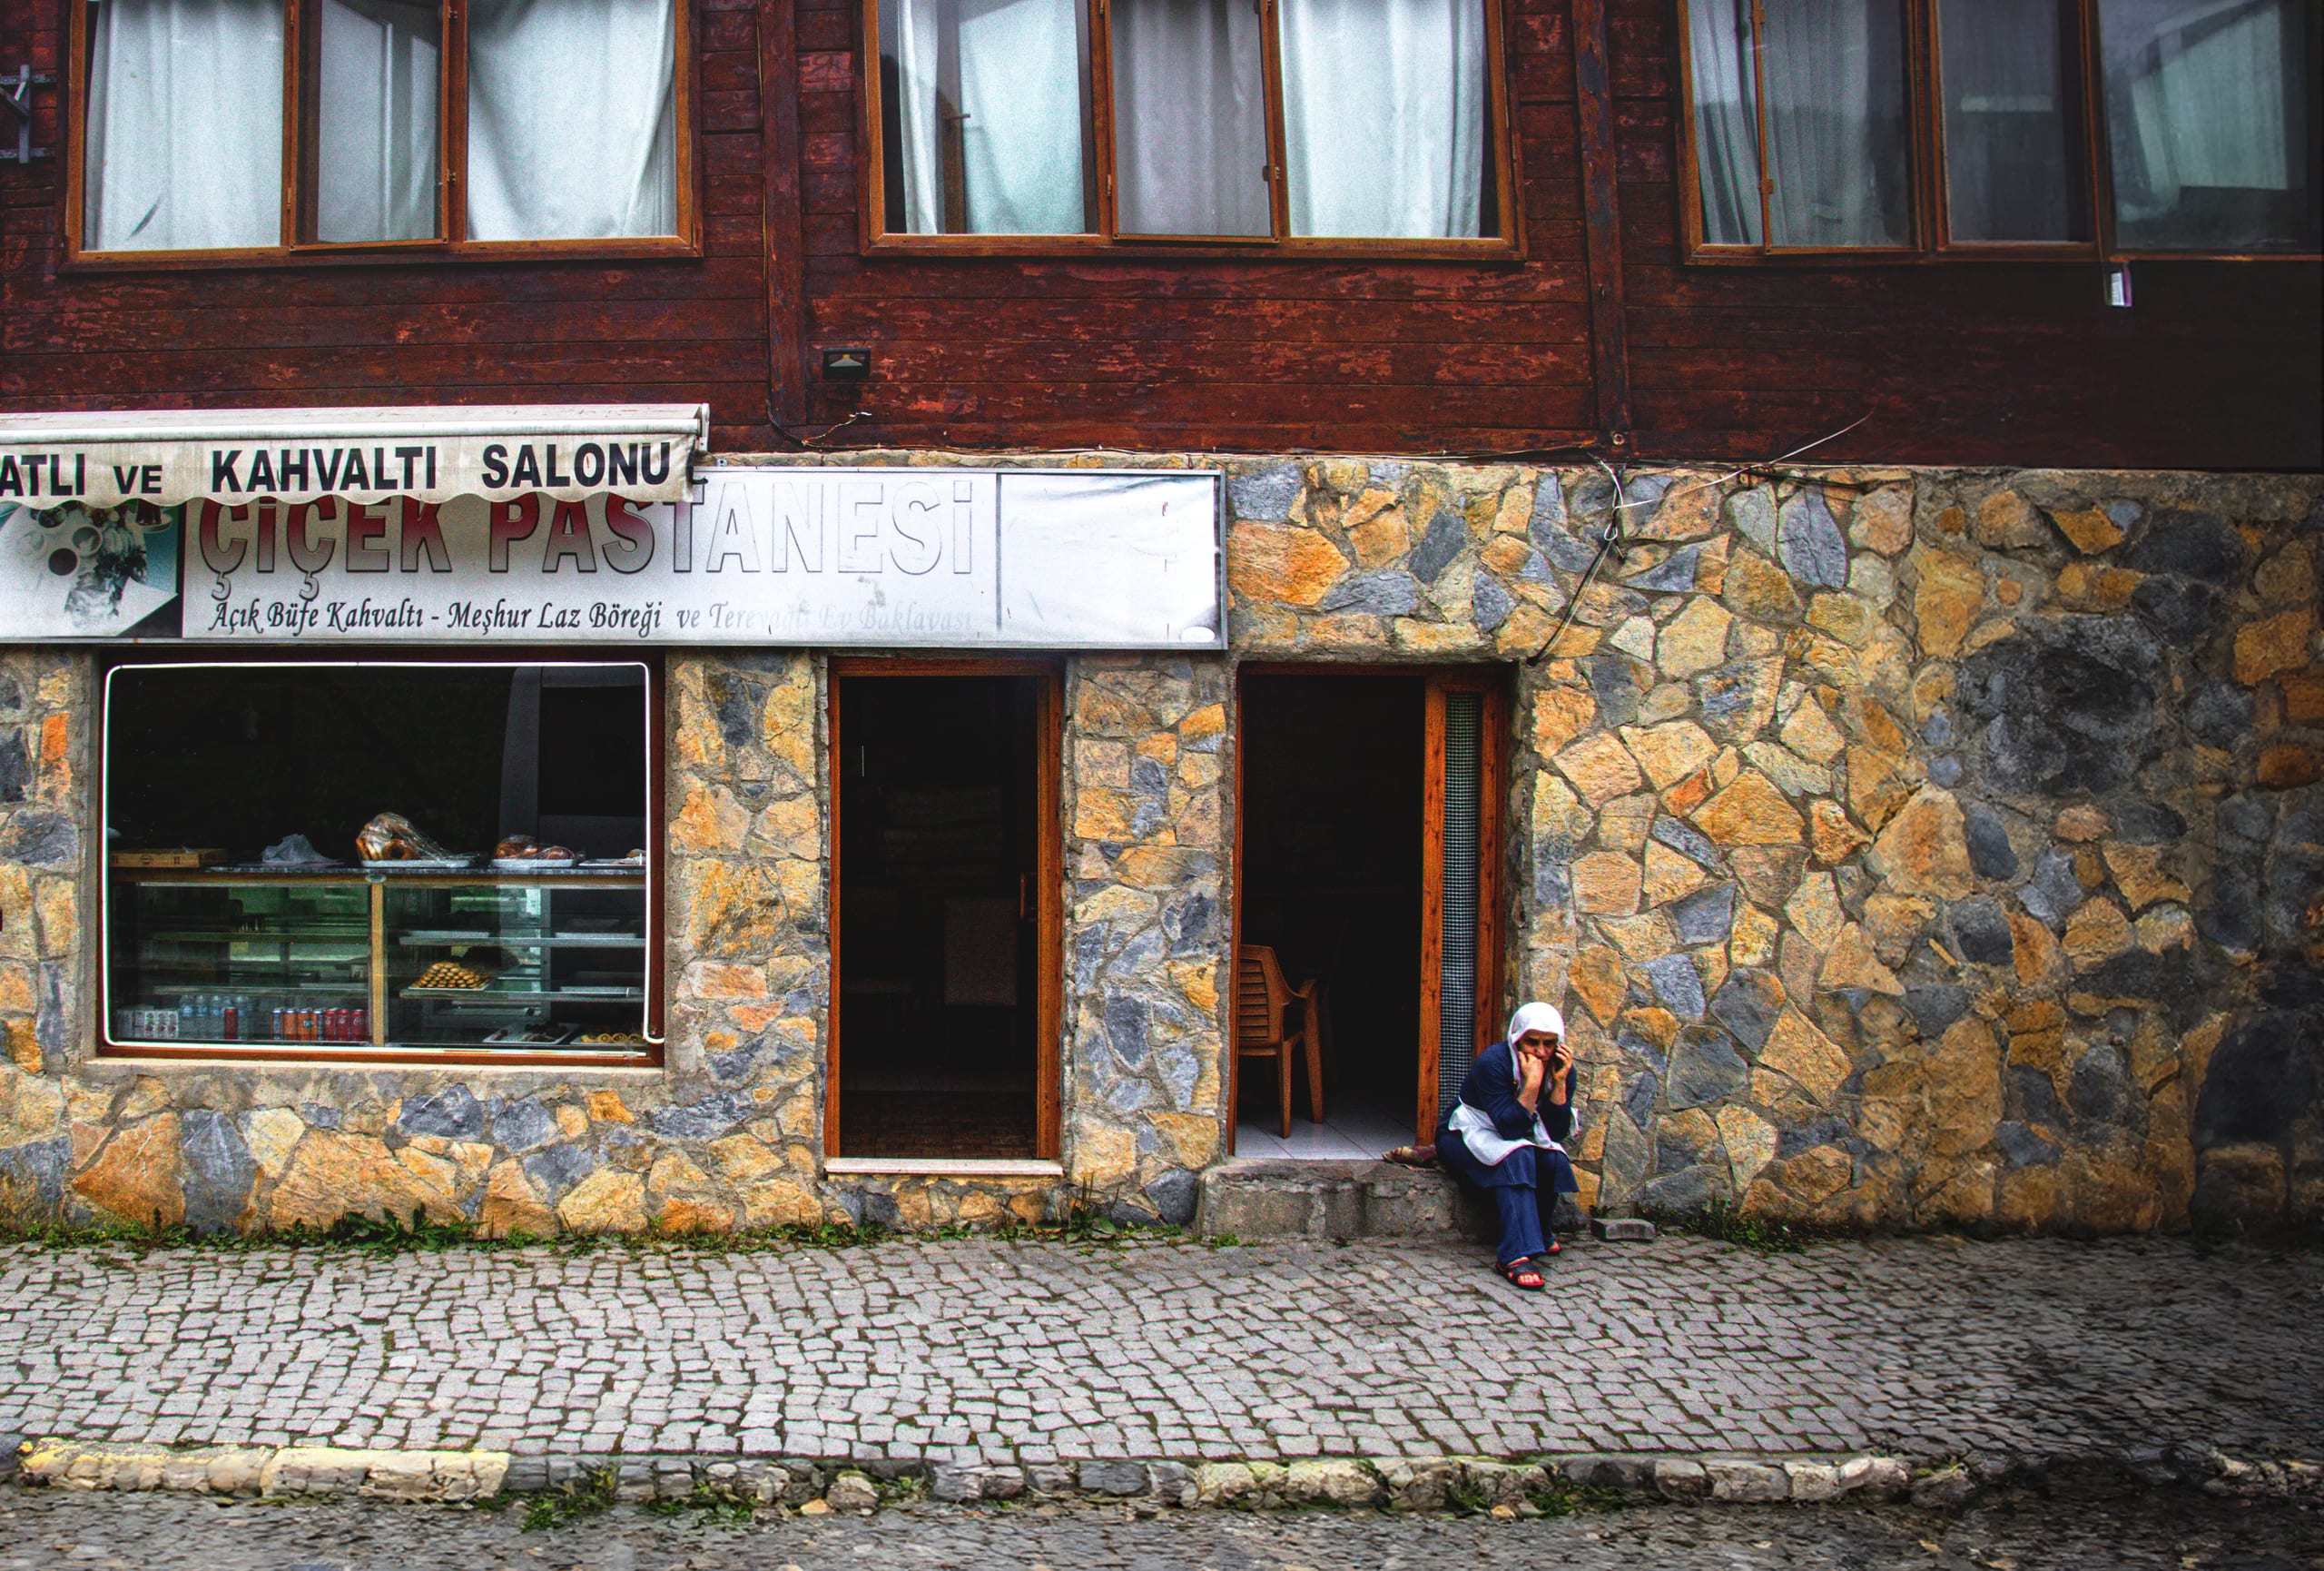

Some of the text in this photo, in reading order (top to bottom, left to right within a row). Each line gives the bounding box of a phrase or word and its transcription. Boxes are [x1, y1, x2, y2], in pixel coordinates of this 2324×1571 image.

[0, 441, 671, 497] ATLI VE KAHVALTI SALONU
[199, 480, 972, 601] ÇİÇEK PASTANESİ
[208, 598, 263, 635] Açık
[267, 599, 319, 637] Büfe
[327, 598, 423, 632] Kahvaltı
[447, 598, 532, 635] Meşhur
[537, 602, 581, 628] Laz
[590, 601, 663, 637] Böreği
[676, 608, 701, 628] ve
